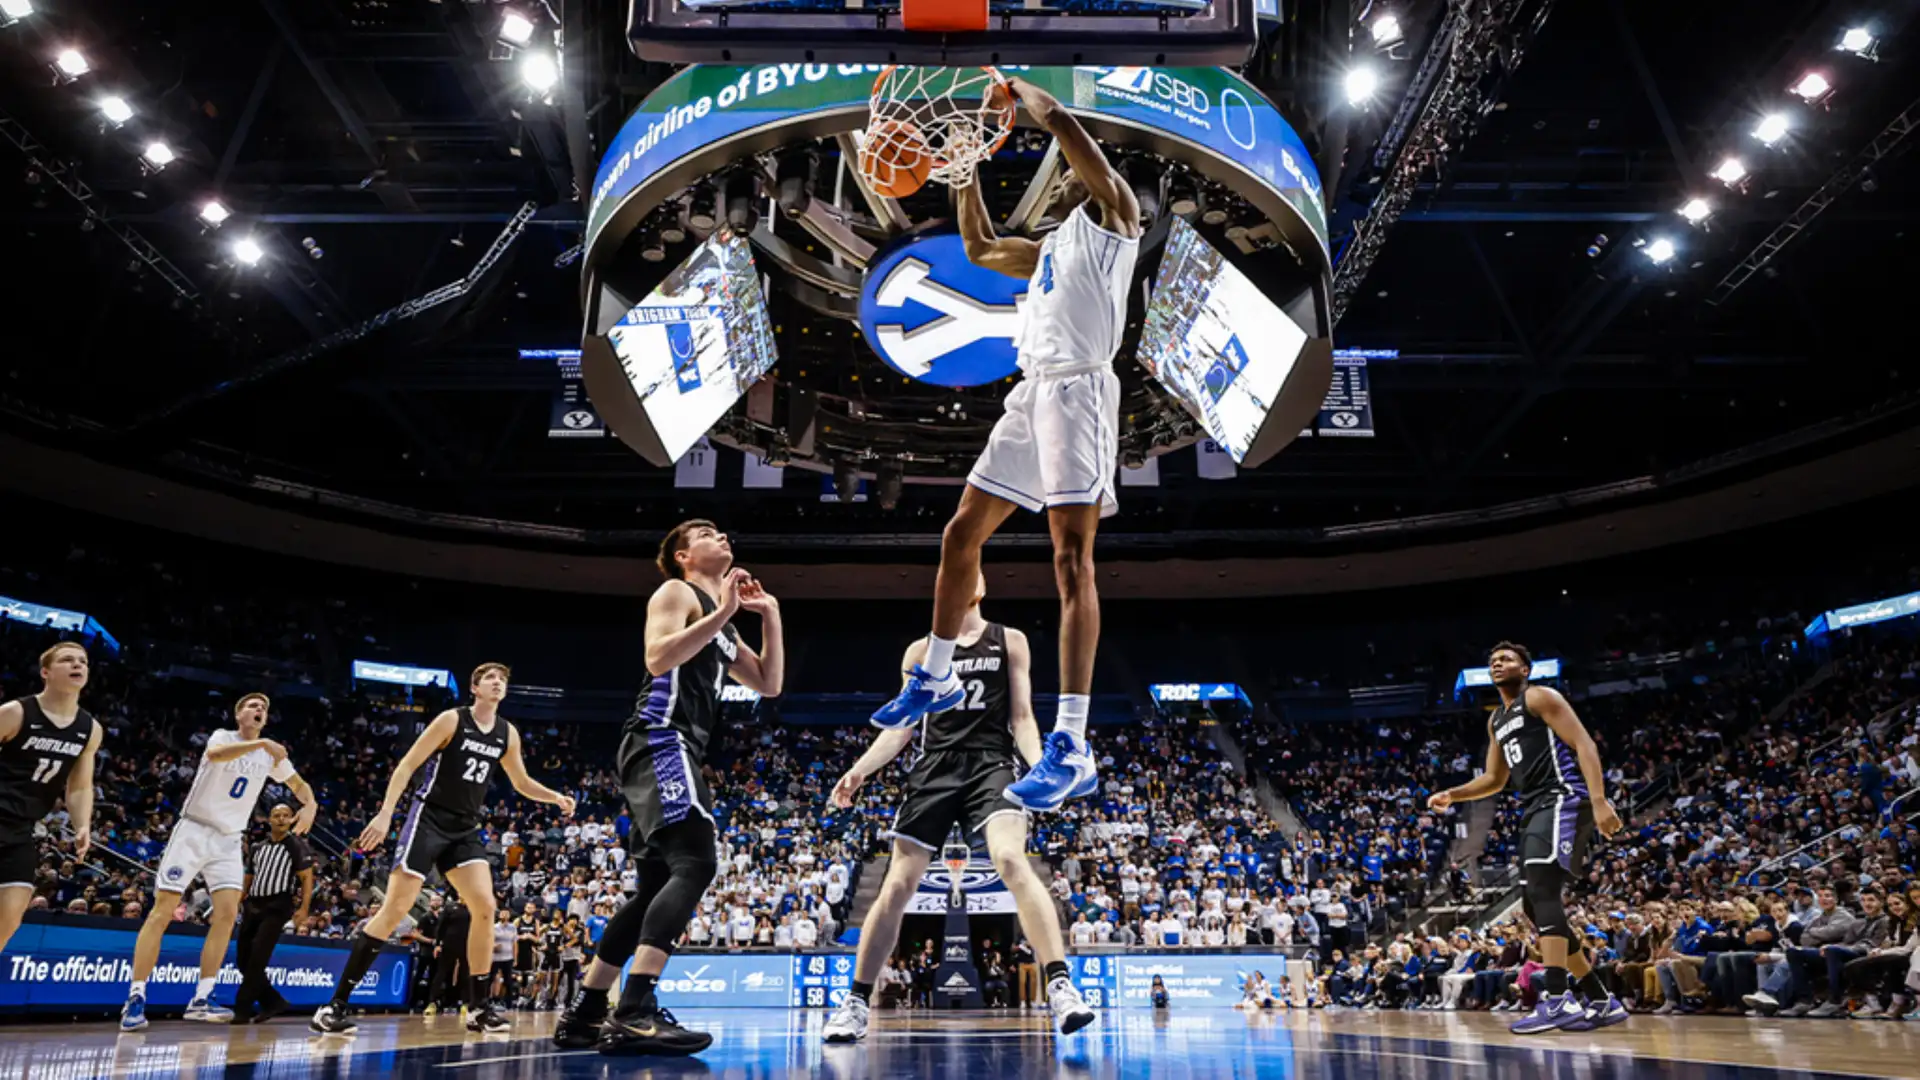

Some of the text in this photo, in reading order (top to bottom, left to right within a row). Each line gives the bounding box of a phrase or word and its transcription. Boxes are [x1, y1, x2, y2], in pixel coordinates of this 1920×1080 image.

[1155, 73, 1209, 114] SBD
[634, 96, 712, 160] airline
[717, 72, 750, 108] of
[757, 63, 828, 95] BYU
[1038, 253, 1054, 295] 4
[1155, 684, 1200, 700] ROC
[21, 736, 84, 757] PORTLAND
[460, 738, 502, 759] PORTLAND
[1503, 738, 1523, 768] 15
[462, 757, 490, 784] 23
[229, 776, 249, 799] 0
[10, 956, 48, 982] The
[52, 956, 119, 983] official
[287, 967, 334, 988] athletics.
[809, 956, 825, 975] 49
[1083, 957, 1100, 975] 49
[1124, 965, 1144, 975] The
[1146, 964, 1184, 976] official
[659, 979, 727, 993] eeze
[807, 987, 824, 1005] 58
[1084, 988, 1100, 1007] 58
